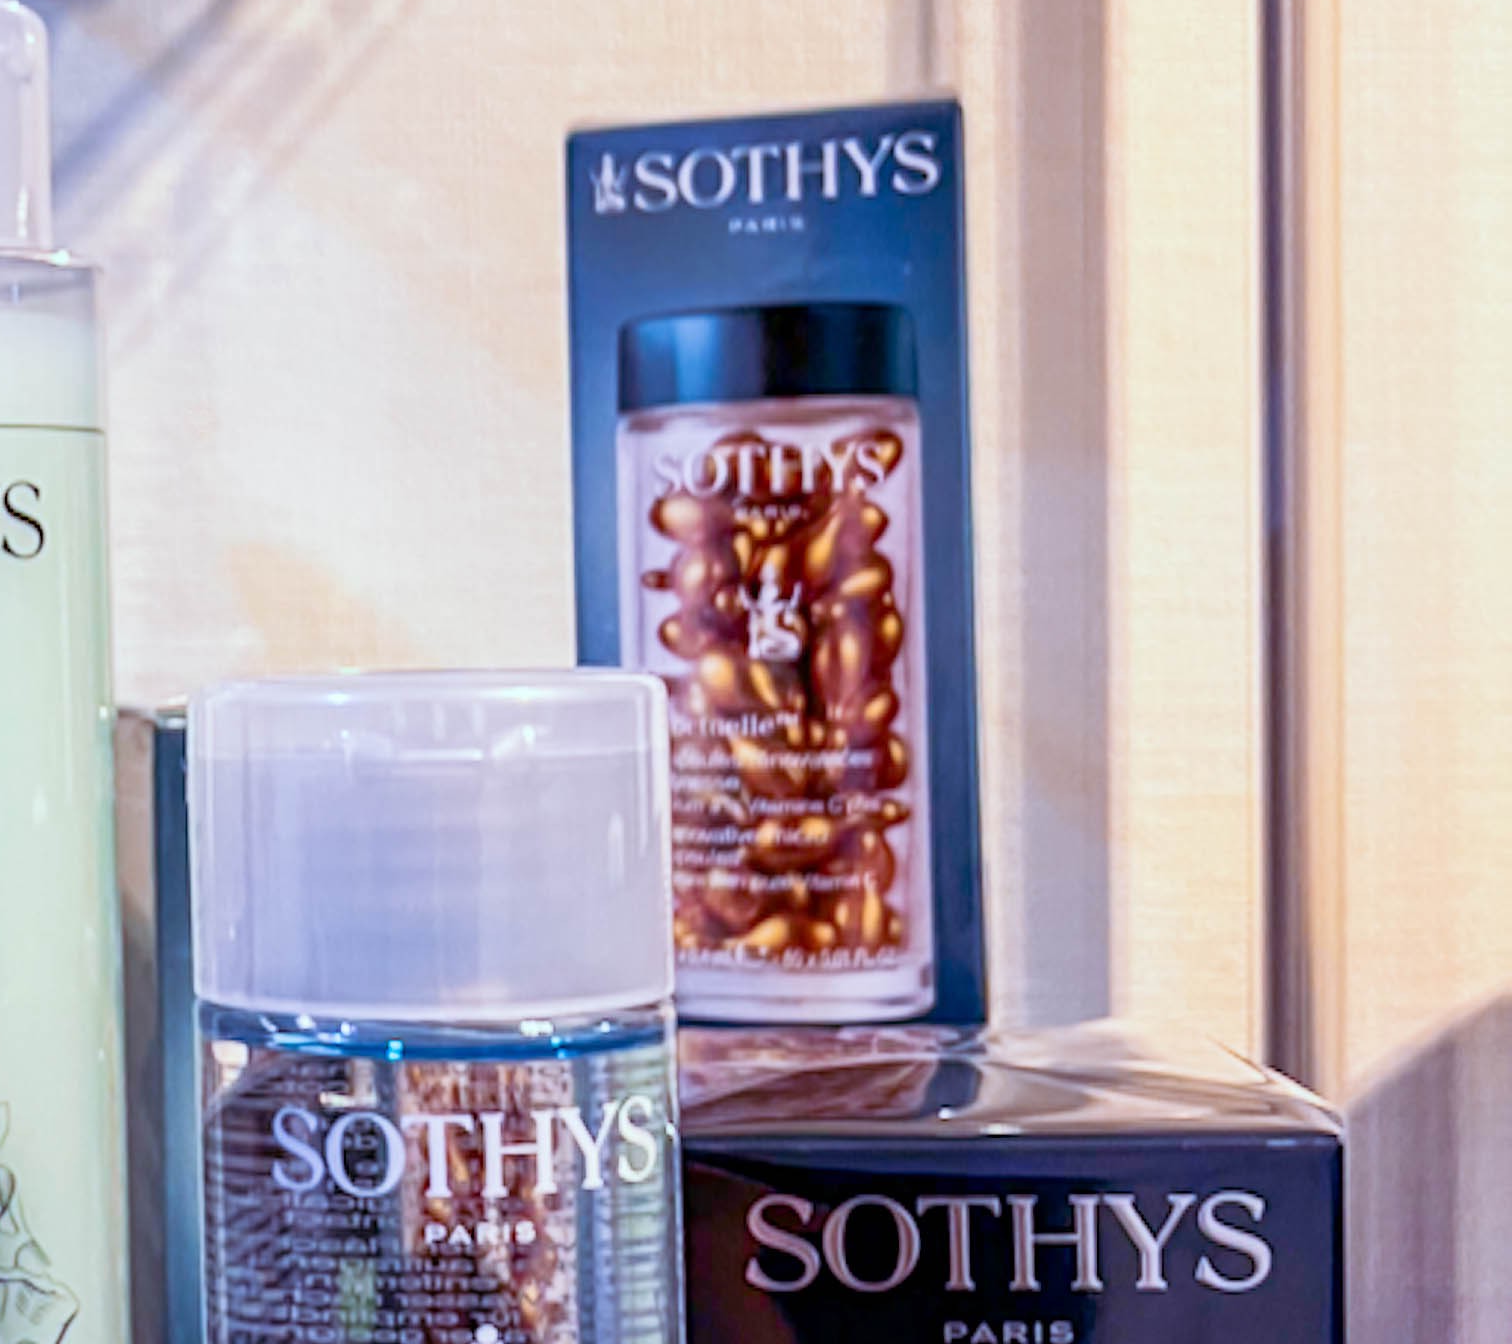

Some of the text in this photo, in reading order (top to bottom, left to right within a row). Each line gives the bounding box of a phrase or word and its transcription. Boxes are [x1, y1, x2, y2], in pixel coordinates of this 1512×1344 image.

[634, 132, 941, 212] SOTHYS
[654, 439, 886, 497] SOTHYS
[271, 1096, 657, 1198] SOTHYS
[425, 1222, 536, 1247] PARIS
[745, 1189, 1274, 1295] SOTHYS
